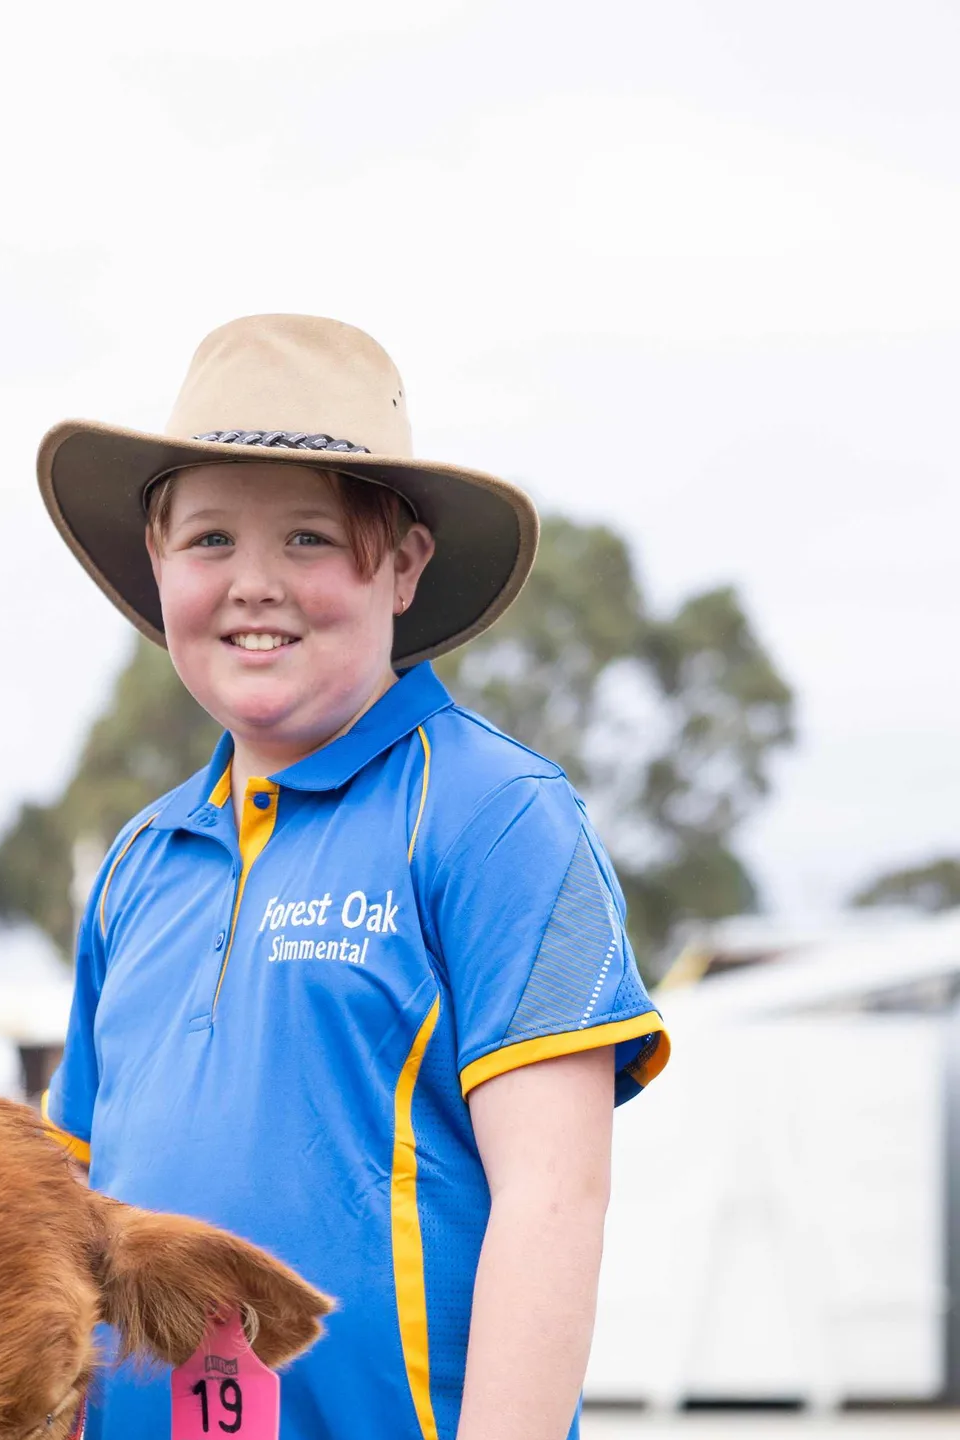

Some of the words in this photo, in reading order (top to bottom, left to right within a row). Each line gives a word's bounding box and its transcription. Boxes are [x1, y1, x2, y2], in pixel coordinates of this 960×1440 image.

[258, 892, 332, 931] Forest
[341, 890, 399, 933] Oak
[268, 935, 370, 964] Simmental
[192, 1378, 243, 1434] 19
